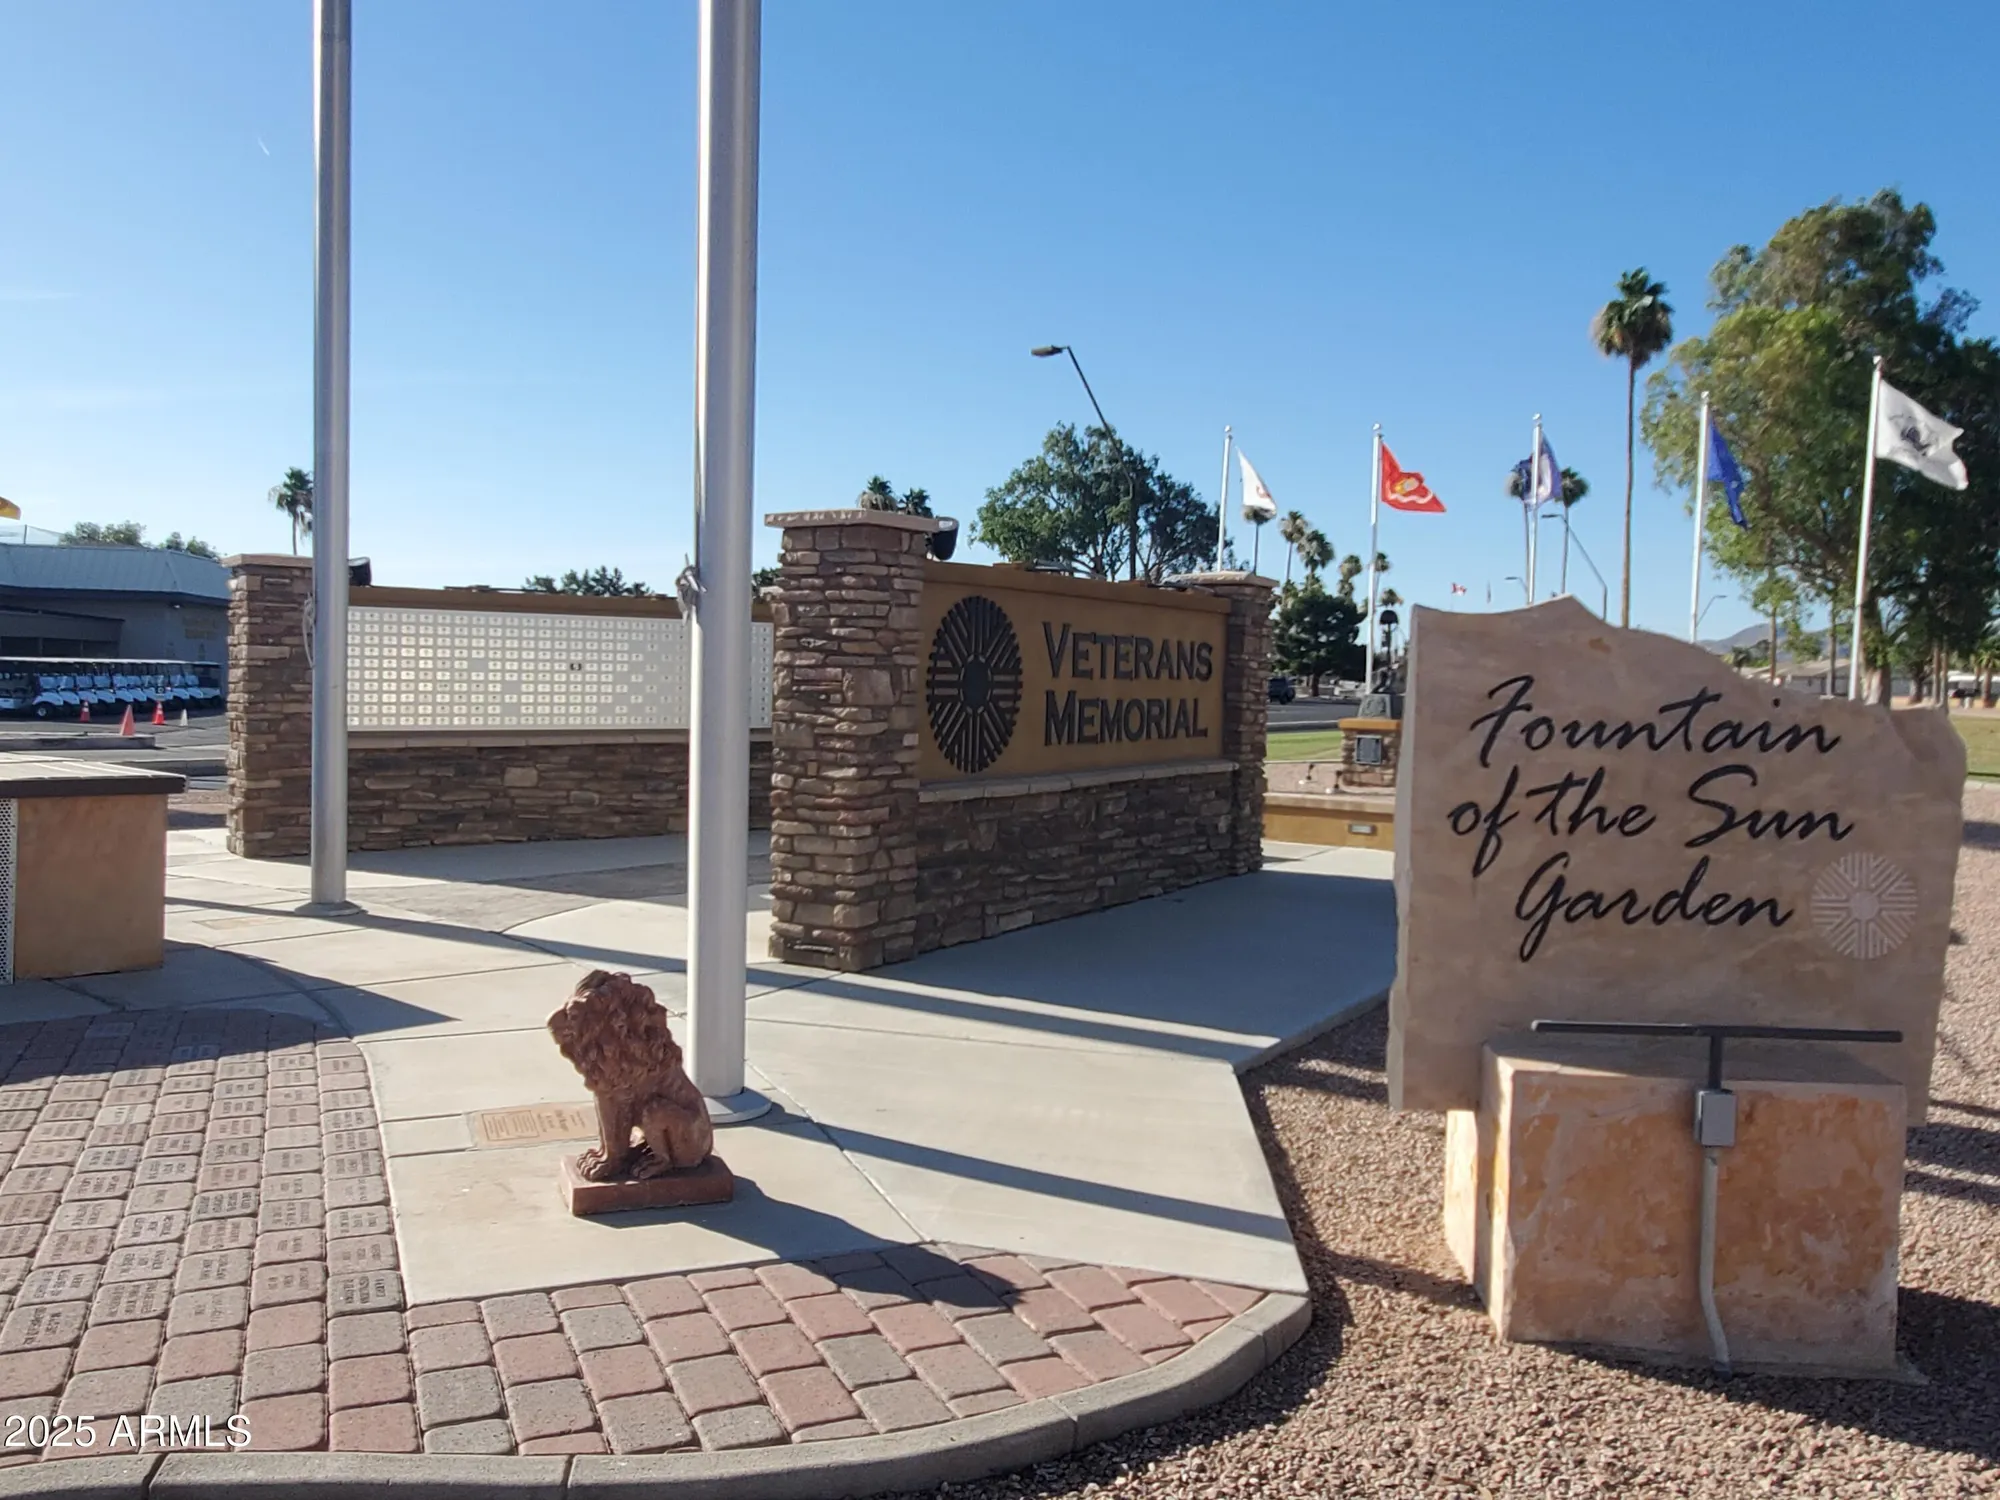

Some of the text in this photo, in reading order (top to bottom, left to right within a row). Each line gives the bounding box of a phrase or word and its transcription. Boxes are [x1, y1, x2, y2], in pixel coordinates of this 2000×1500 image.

[1042, 621, 1213, 682] VETERANS
[1044, 690, 1208, 746] MEMORIAL
[1470, 674, 1841, 768] Fountain
[1447, 764, 1854, 878] of the Sun
[1515, 851, 1794, 963] Garden
